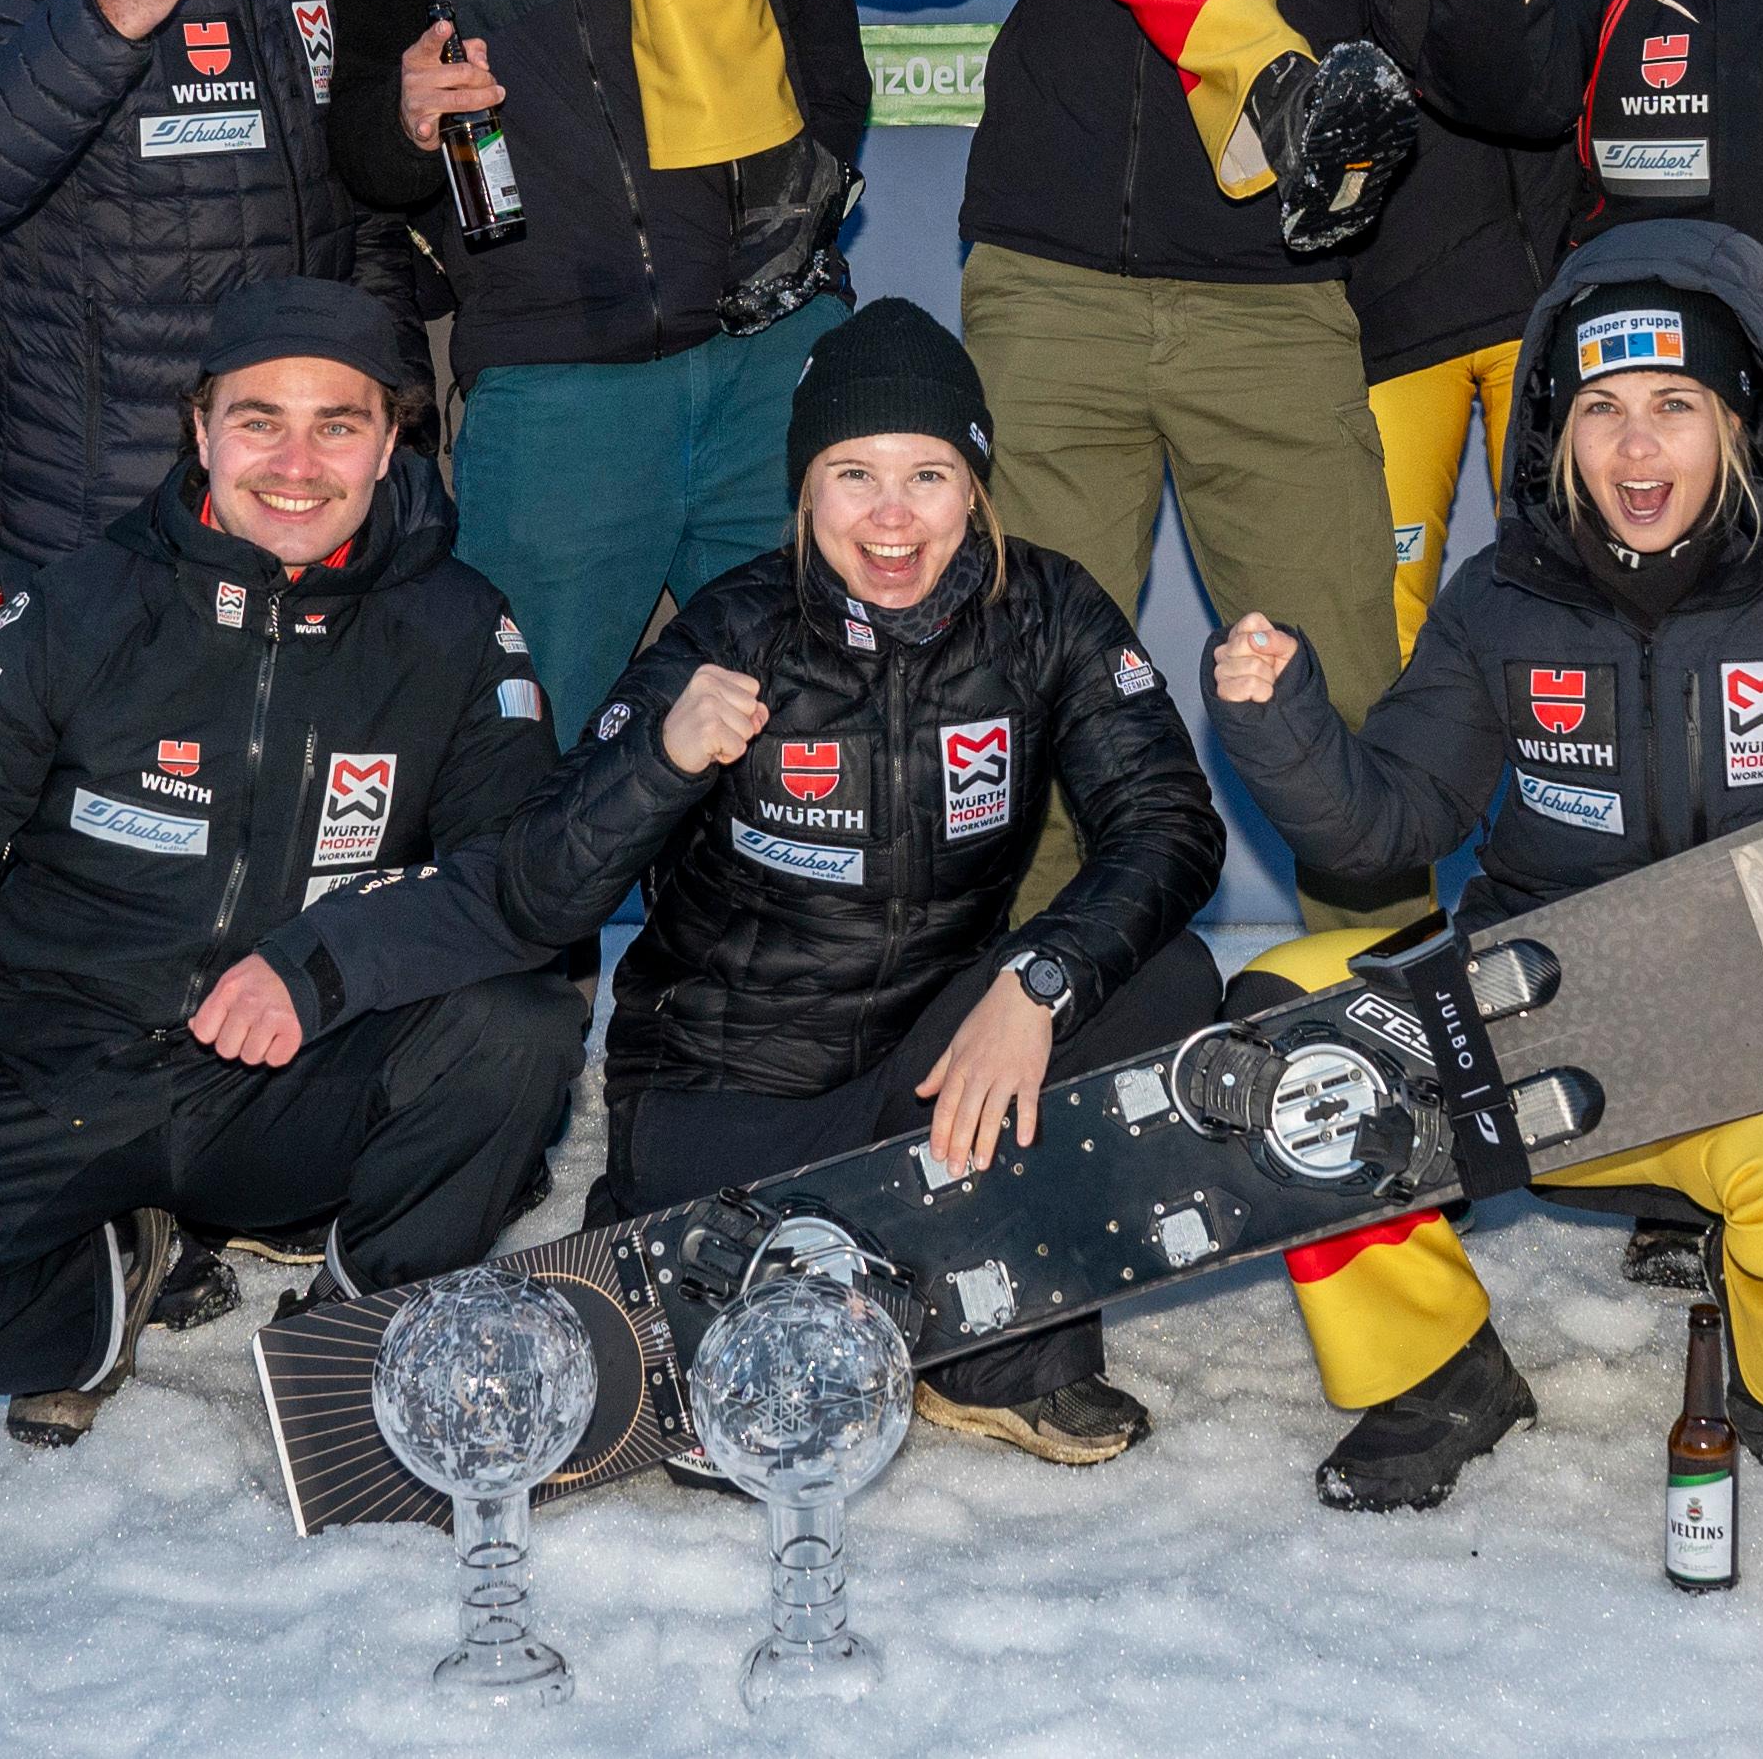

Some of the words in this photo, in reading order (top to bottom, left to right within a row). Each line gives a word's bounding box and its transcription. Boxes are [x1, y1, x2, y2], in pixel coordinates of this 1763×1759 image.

[145, 113, 259, 146] Schubert
[1602, 144, 1704, 169] Schubert
[1578, 321, 1627, 341] schaper
[1630, 315, 1680, 329] gruppe
[950, 801, 1006, 822] MODYF
[1524, 785, 1616, 821] Schubert
[75, 808, 205, 845] Schubert
[950, 814, 1006, 833] WORKWEAR
[318, 850, 373, 861] WORKWEAR
[320, 838, 377, 849] MODYF
[740, 841, 860, 873] Schubert
[1435, 991, 1474, 1069] JULBO
[1671, 1522, 1724, 1539] VELTINS
